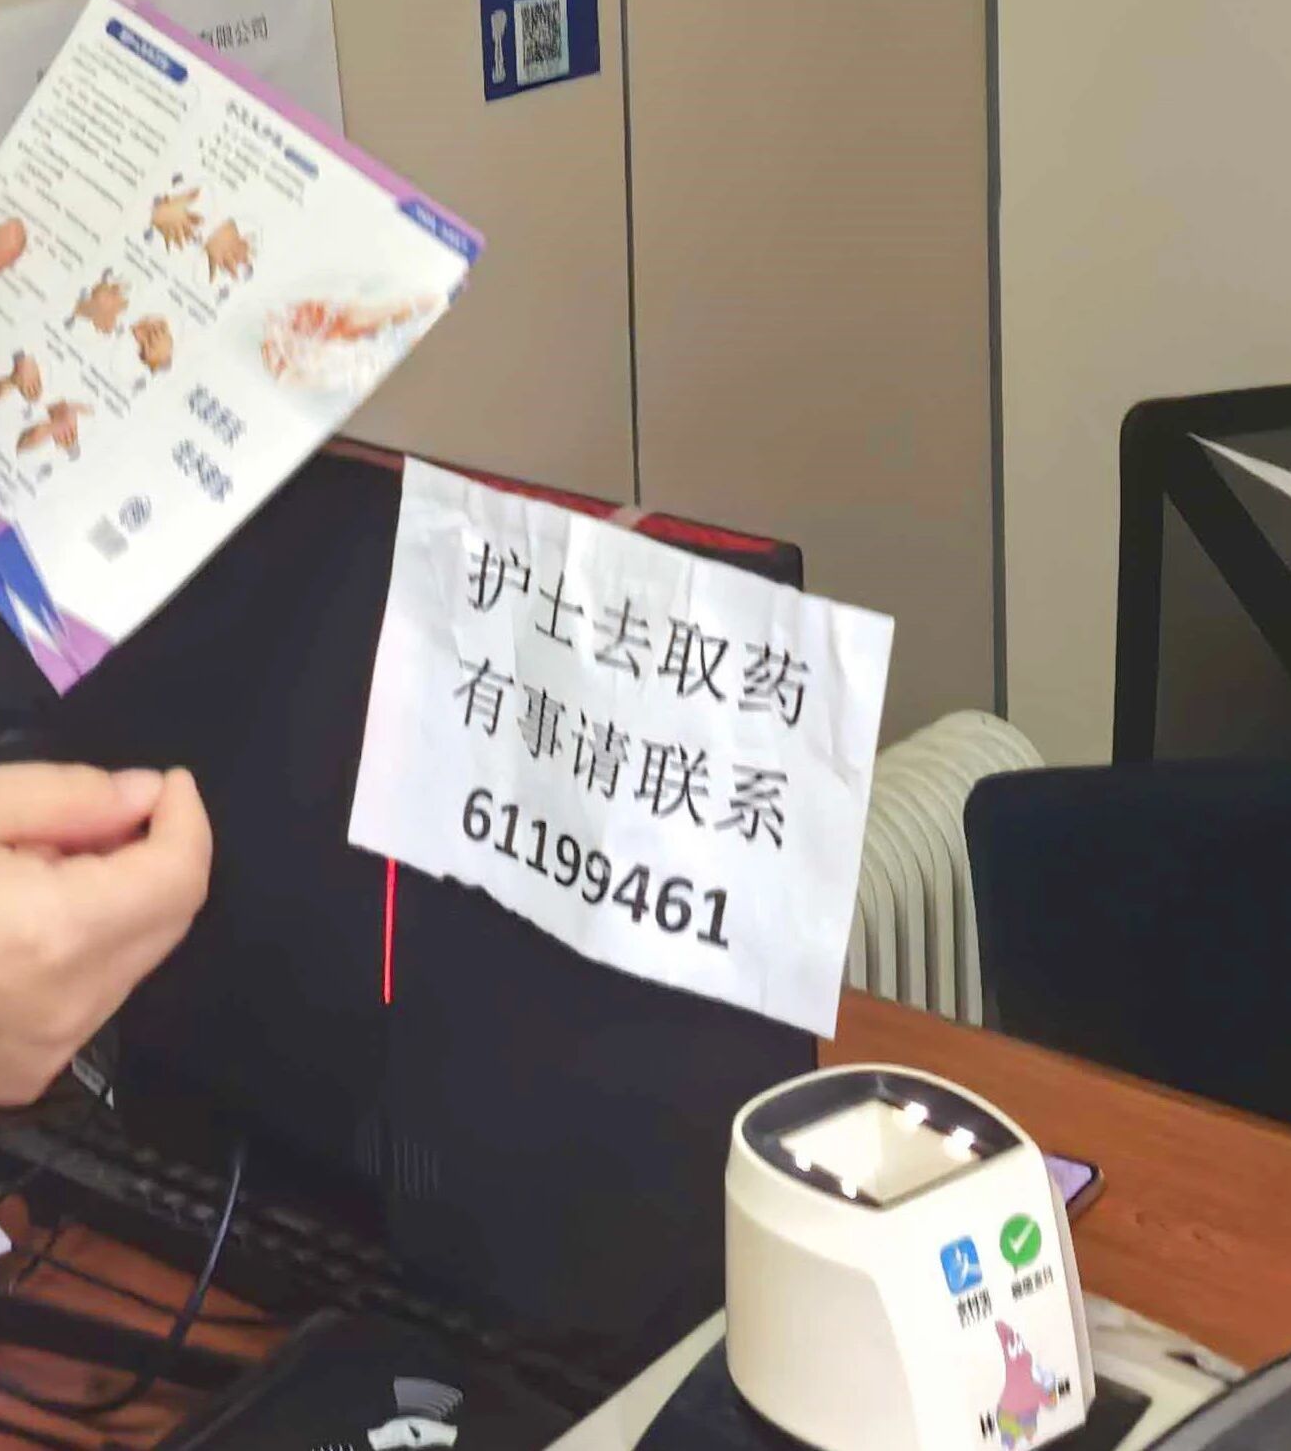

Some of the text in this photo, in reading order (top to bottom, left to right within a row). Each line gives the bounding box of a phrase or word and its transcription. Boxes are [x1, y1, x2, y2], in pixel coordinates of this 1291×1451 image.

[468, 540, 810, 729] 护士去取药
[453, 657, 789, 850] 有事请联系
[461, 786, 730, 950] 61199461
